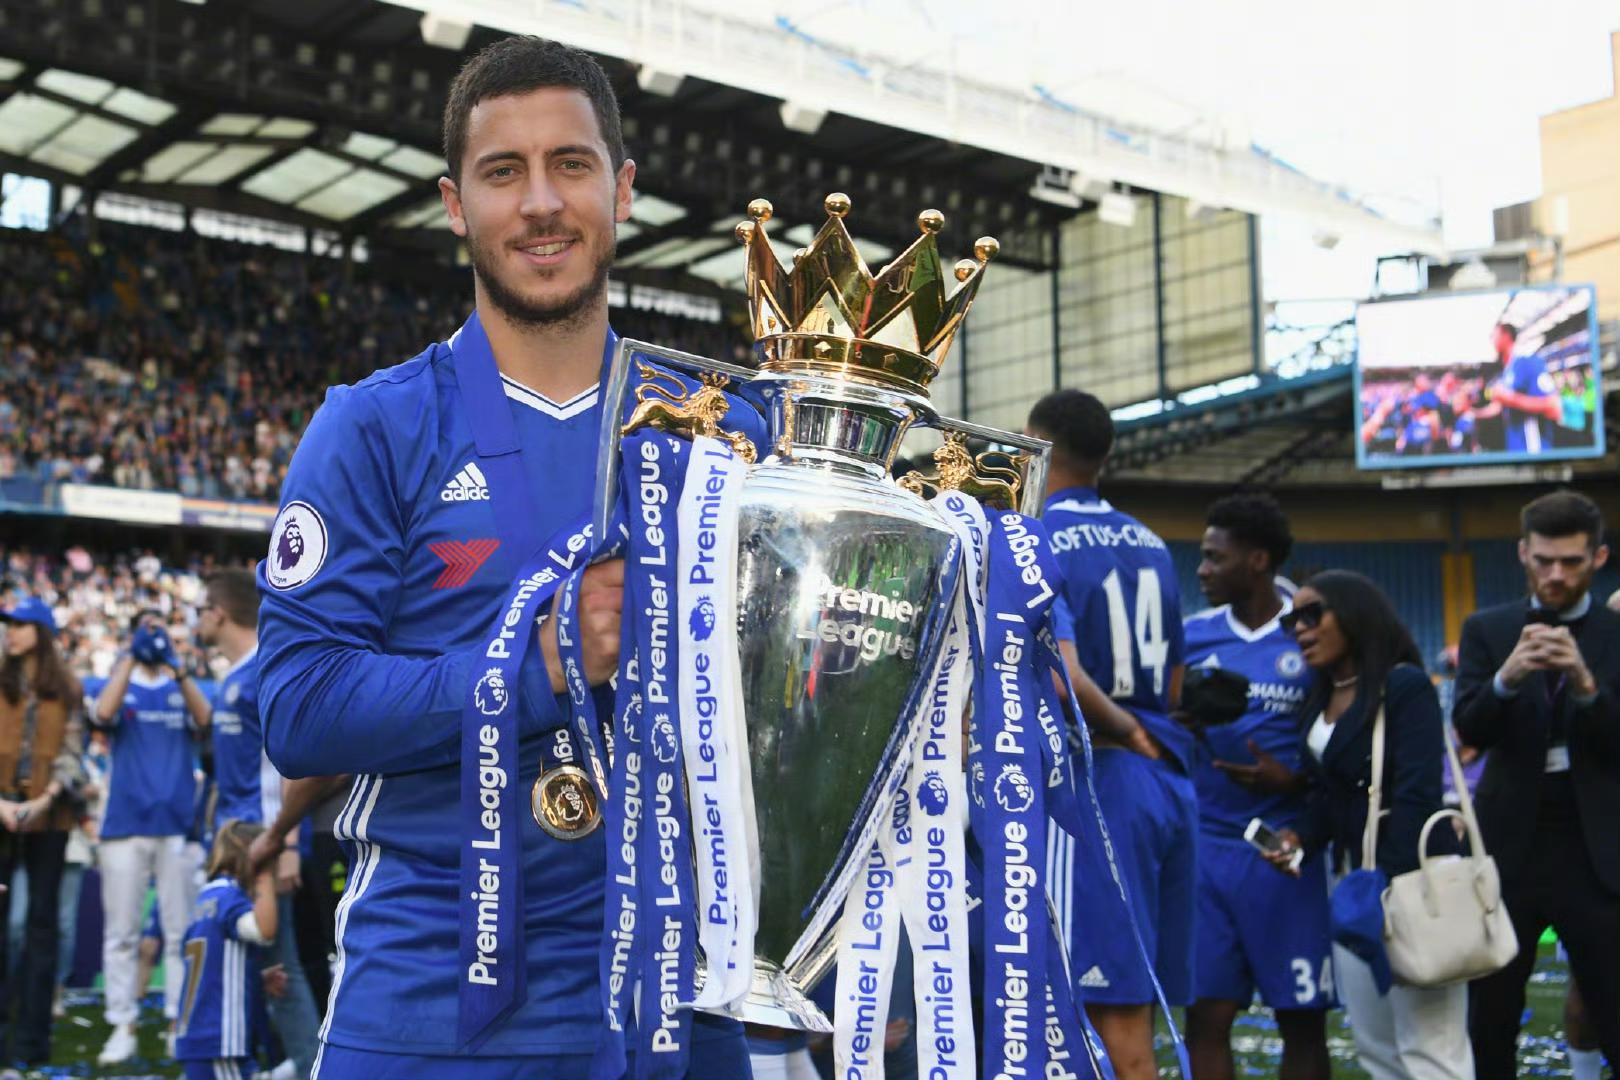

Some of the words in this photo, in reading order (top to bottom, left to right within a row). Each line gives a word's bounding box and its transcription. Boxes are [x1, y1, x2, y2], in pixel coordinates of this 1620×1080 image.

[640, 441, 669, 566] League
[689, 465, 728, 584] Premier
[1000, 514, 1055, 608] League
[487, 567, 560, 659] Premier
[648, 575, 669, 704] Premier
[1102, 568, 1169, 698] 14
[690, 654, 718, 784] League
[923, 645, 960, 761] Premier
[993, 630, 1025, 754] Premier
[472, 724, 507, 850] League
[616, 751, 642, 886] League
[655, 772, 681, 906] League
[468, 858, 500, 985] Premier
[703, 793, 729, 925] Premier
[922, 827, 953, 950] League
[995, 821, 1038, 954] League
[606, 895, 637, 1032] Premier
[653, 916, 682, 1052] Premier
[993, 962, 1029, 1080] remier
